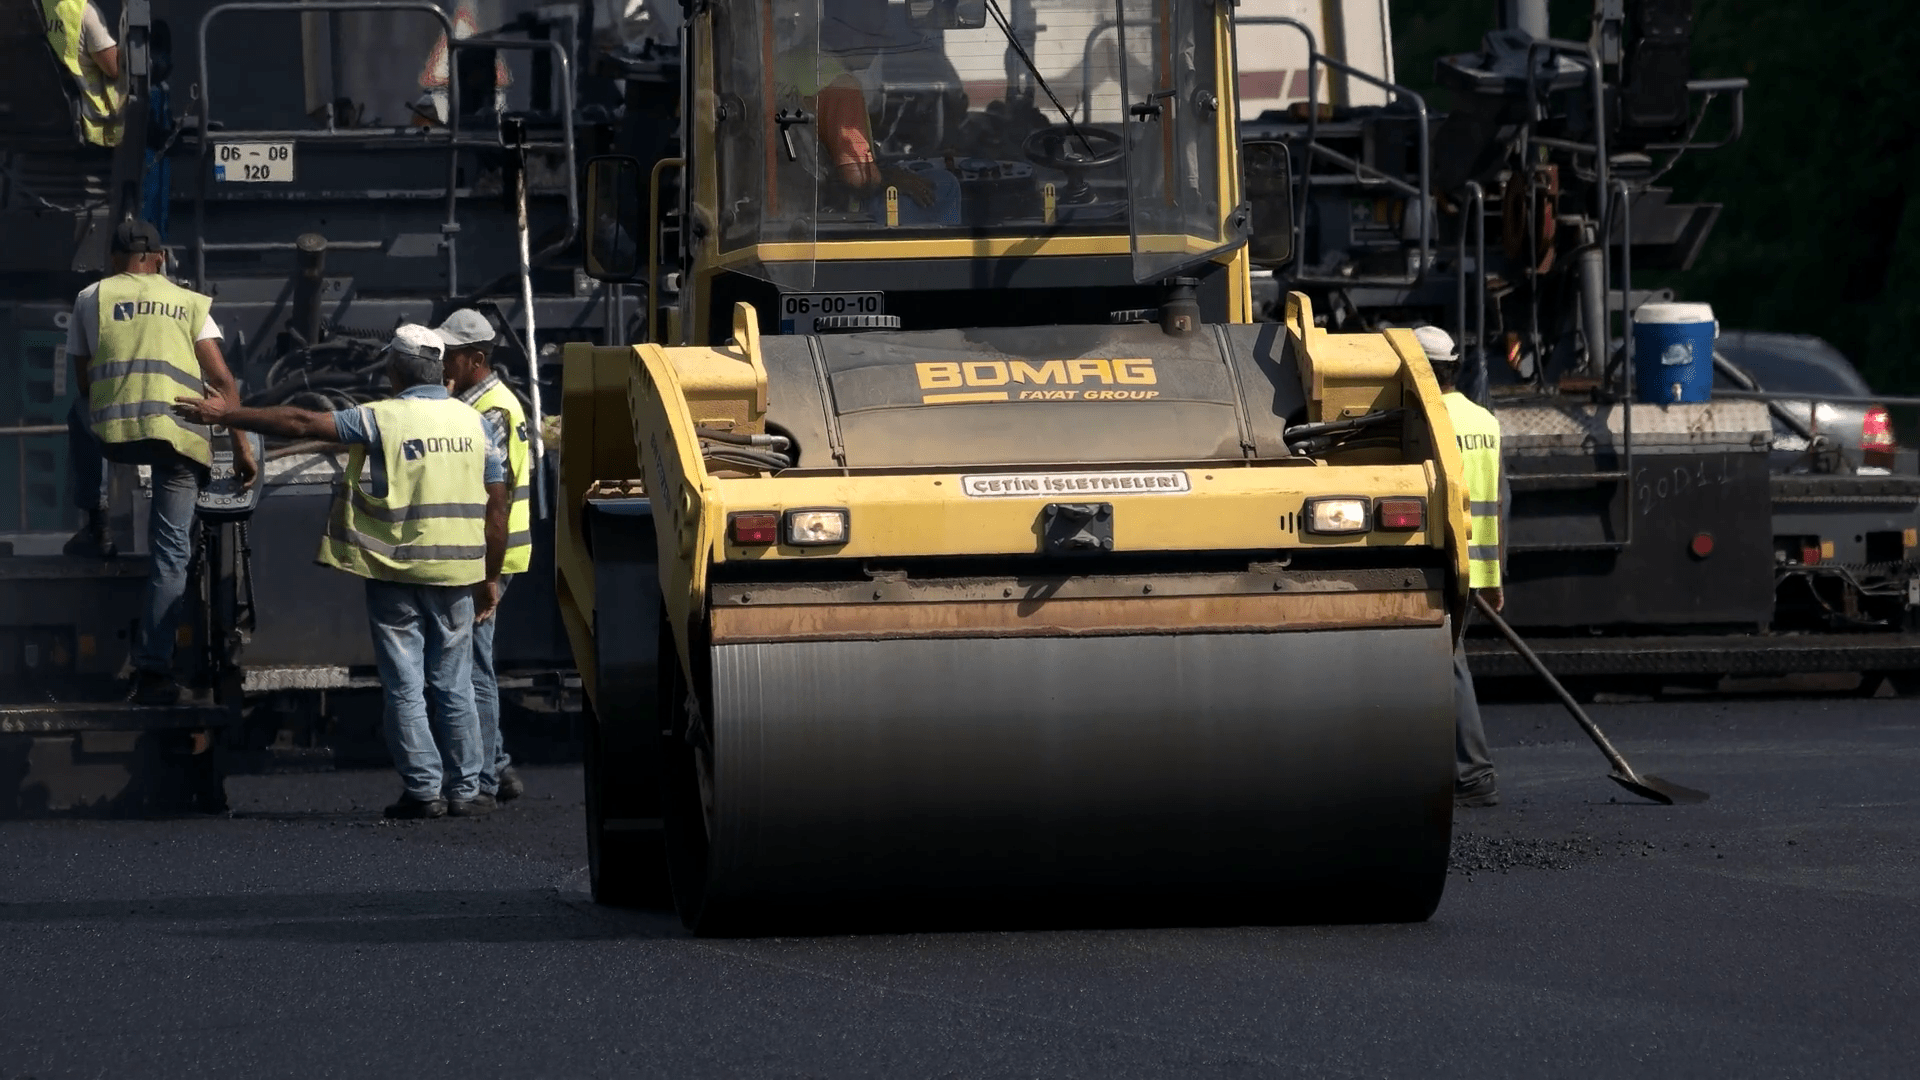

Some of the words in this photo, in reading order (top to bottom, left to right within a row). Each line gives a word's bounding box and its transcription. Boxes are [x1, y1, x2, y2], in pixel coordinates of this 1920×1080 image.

[221, 146, 241, 162] 06
[244, 164, 270, 179] 120
[786, 296, 877, 314] 06-00-10
[915, 358, 1158, 390] BOMAG
[1019, 390, 1082, 400] FAYAT
[1083, 390, 1160, 400] GROUP
[973, 477, 1039, 493] ÇETİN
[1044, 473, 1180, 491] İŞLETMELERİ
